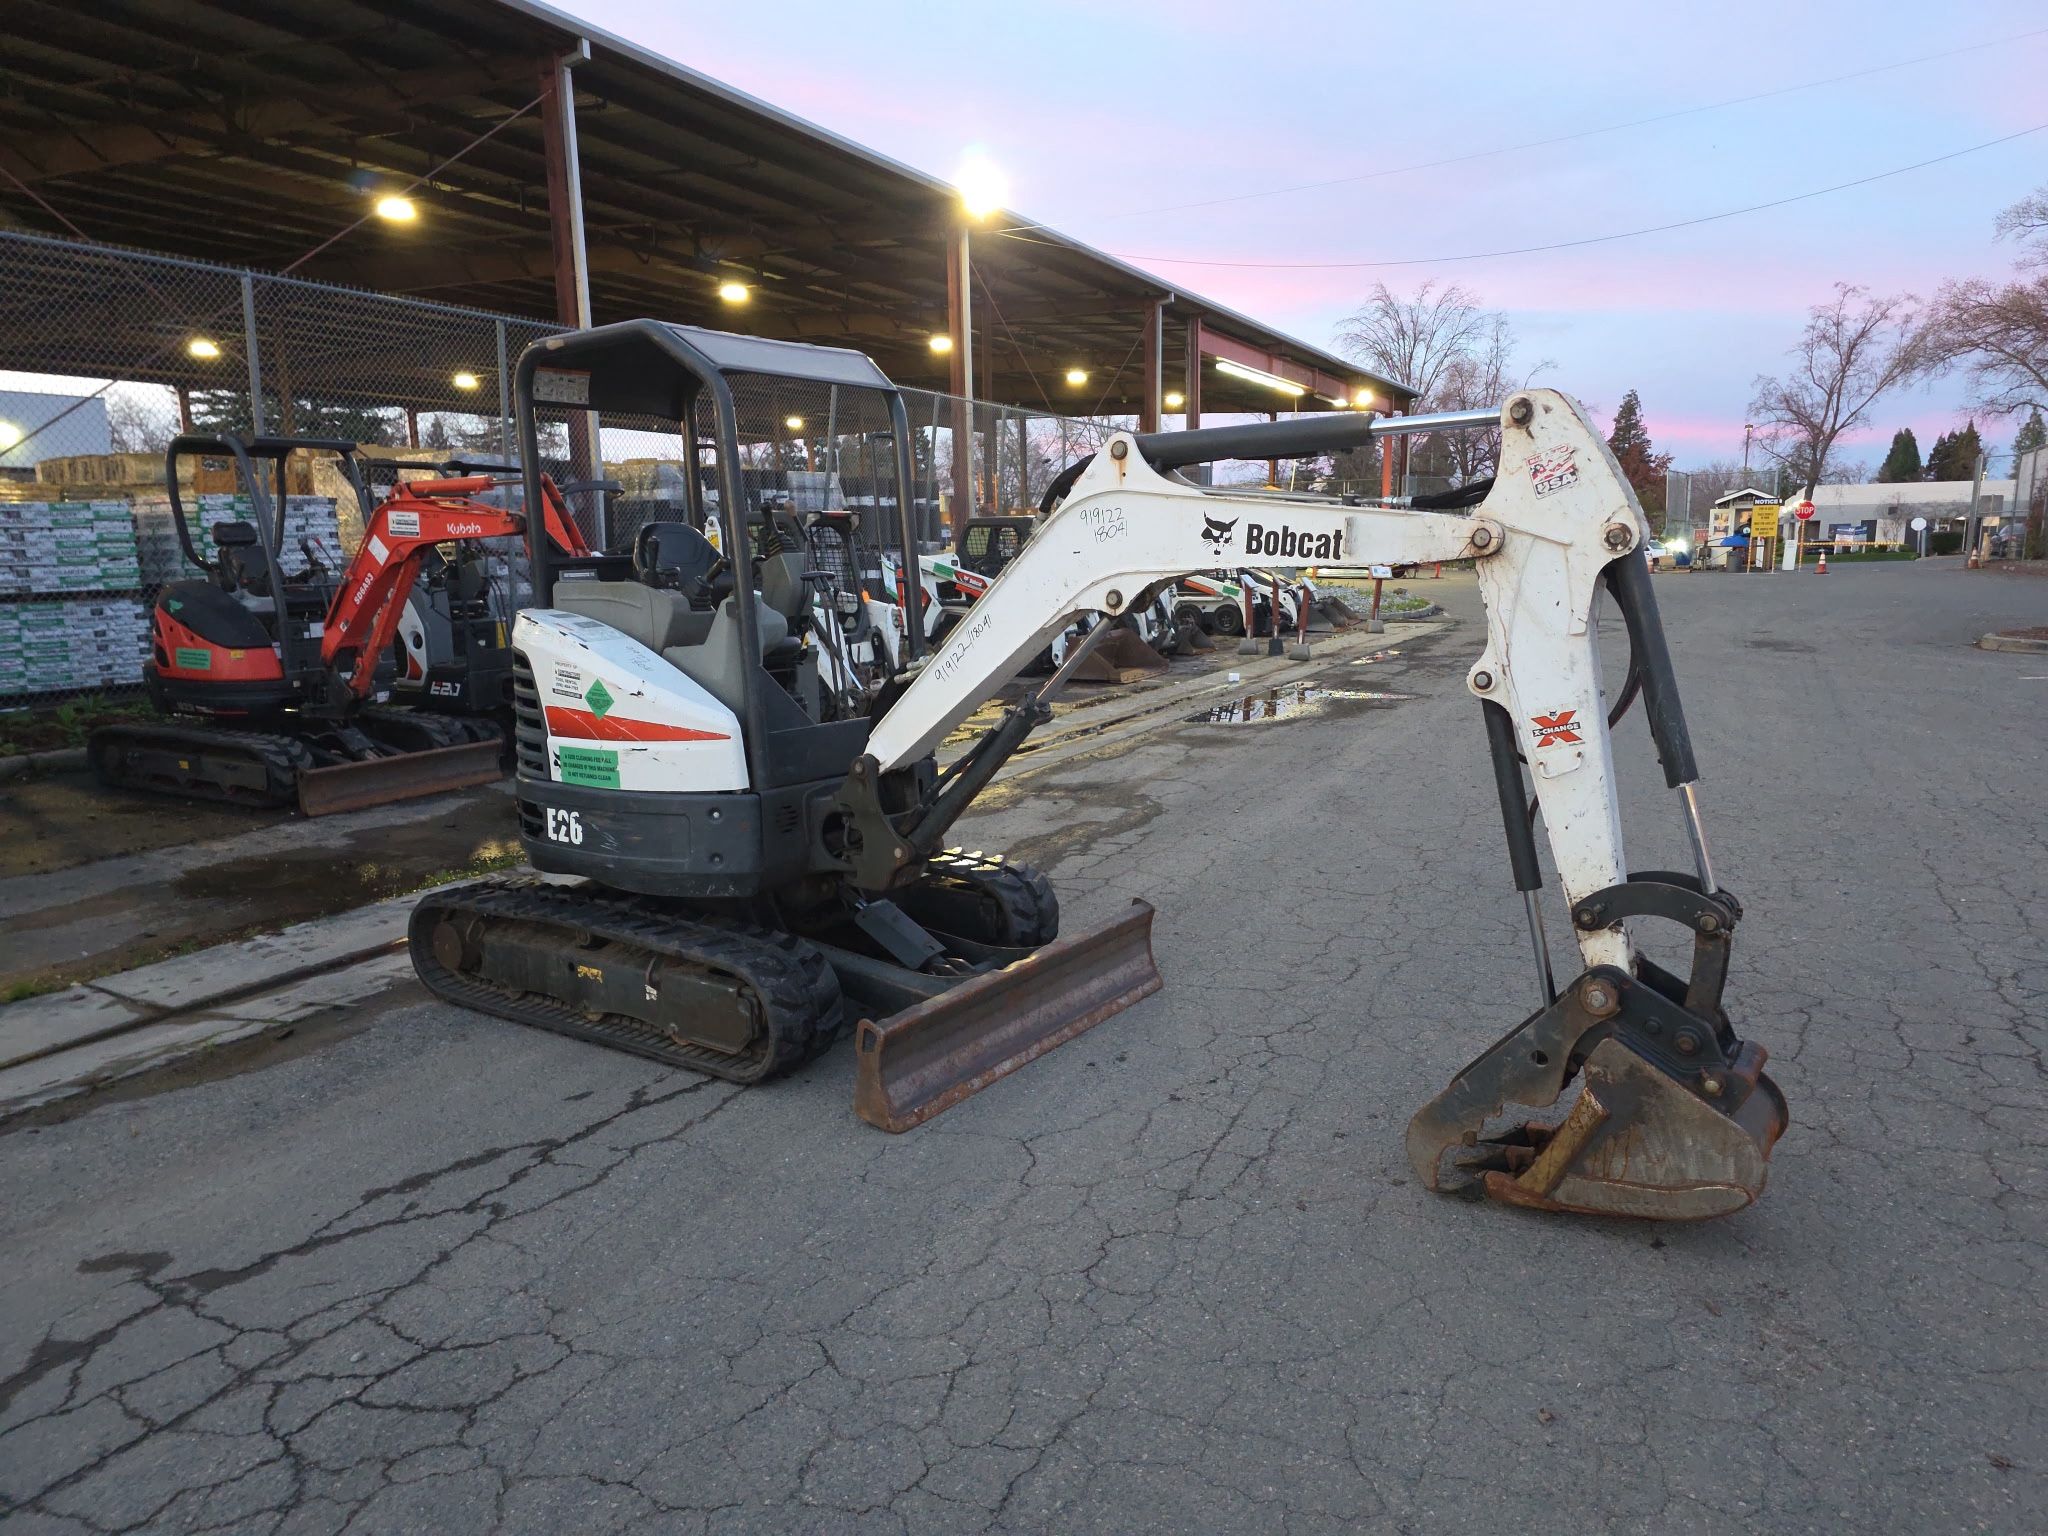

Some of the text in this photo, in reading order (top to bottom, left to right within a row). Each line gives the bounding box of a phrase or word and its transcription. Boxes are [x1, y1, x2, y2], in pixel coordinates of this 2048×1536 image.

[1535, 474, 1574, 495] USA
[1080, 507, 1125, 525] 919122
[1796, 506, 1814, 515] STOP
[446, 522, 482, 535] Kubota
[1093, 520, 1128, 544] 18041
[1246, 524, 1343, 560] Bobcat
[1533, 722, 1580, 737] X-CHANGE
[546, 807, 583, 845] E26
